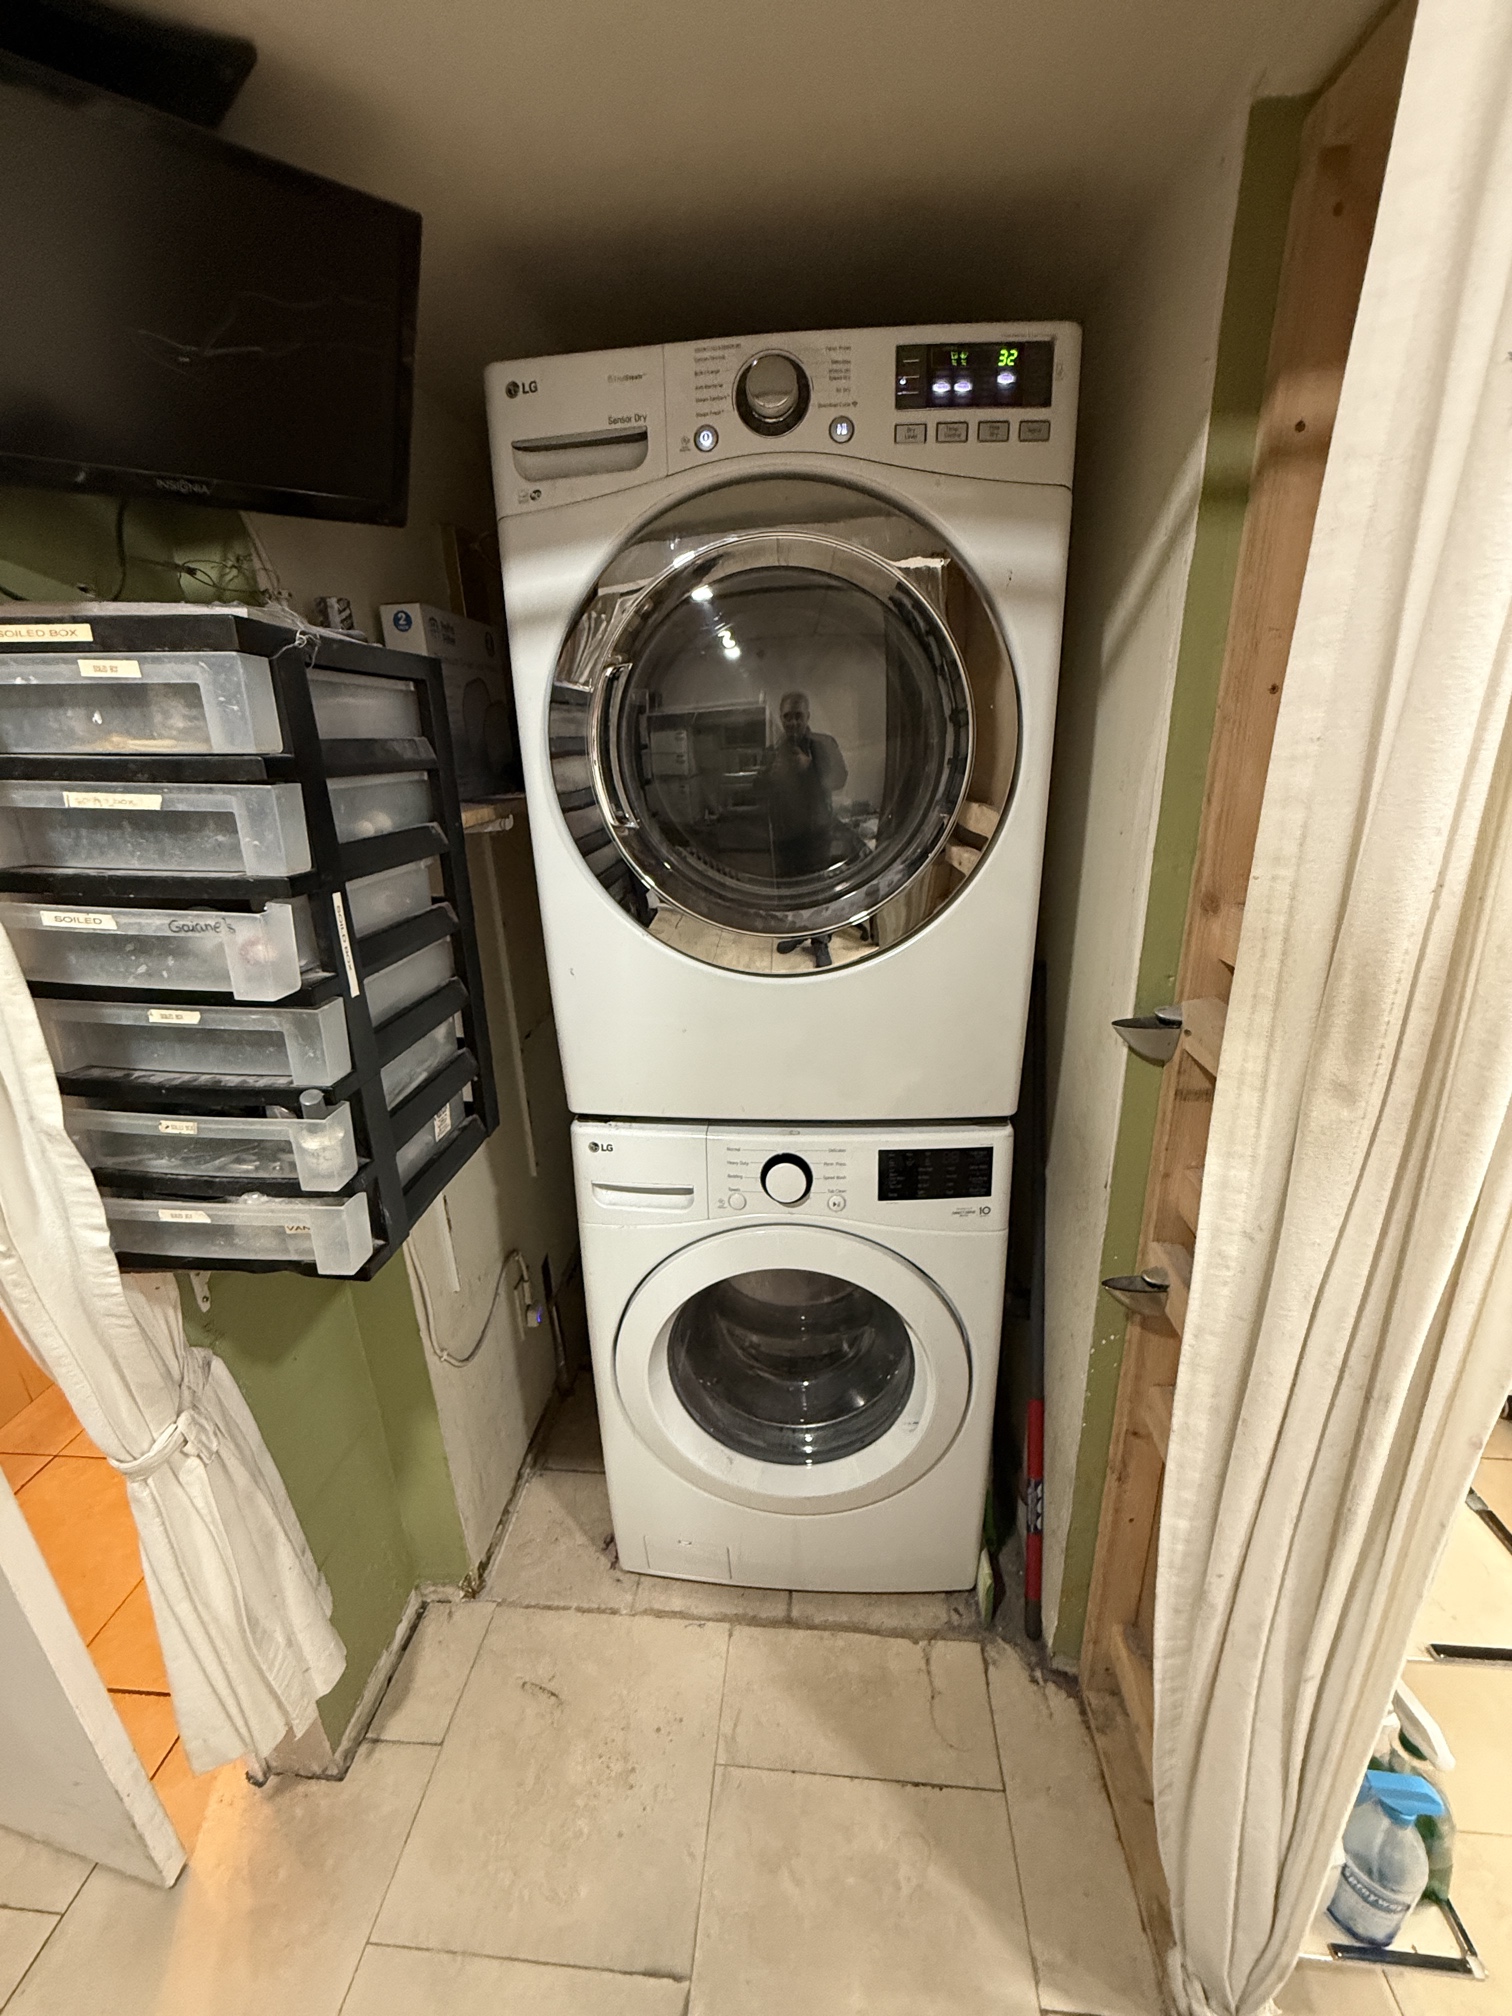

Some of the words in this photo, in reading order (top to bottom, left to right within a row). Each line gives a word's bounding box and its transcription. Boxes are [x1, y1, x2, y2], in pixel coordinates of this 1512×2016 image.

[998, 349, 1018, 367] 32
[522, 380, 538, 394] LG
[608, 415, 632, 425] Sensor
[634, 413, 648, 423] Dry
[156, 478, 211, 496] INSIGNIA
[397, 611, 408, 625] 2
[48, 629, 79, 637] BOX
[54, 915, 103, 925] SOILED
[601, 1143, 614, 1152] LG
[979, 1206, 991, 1215] 10
